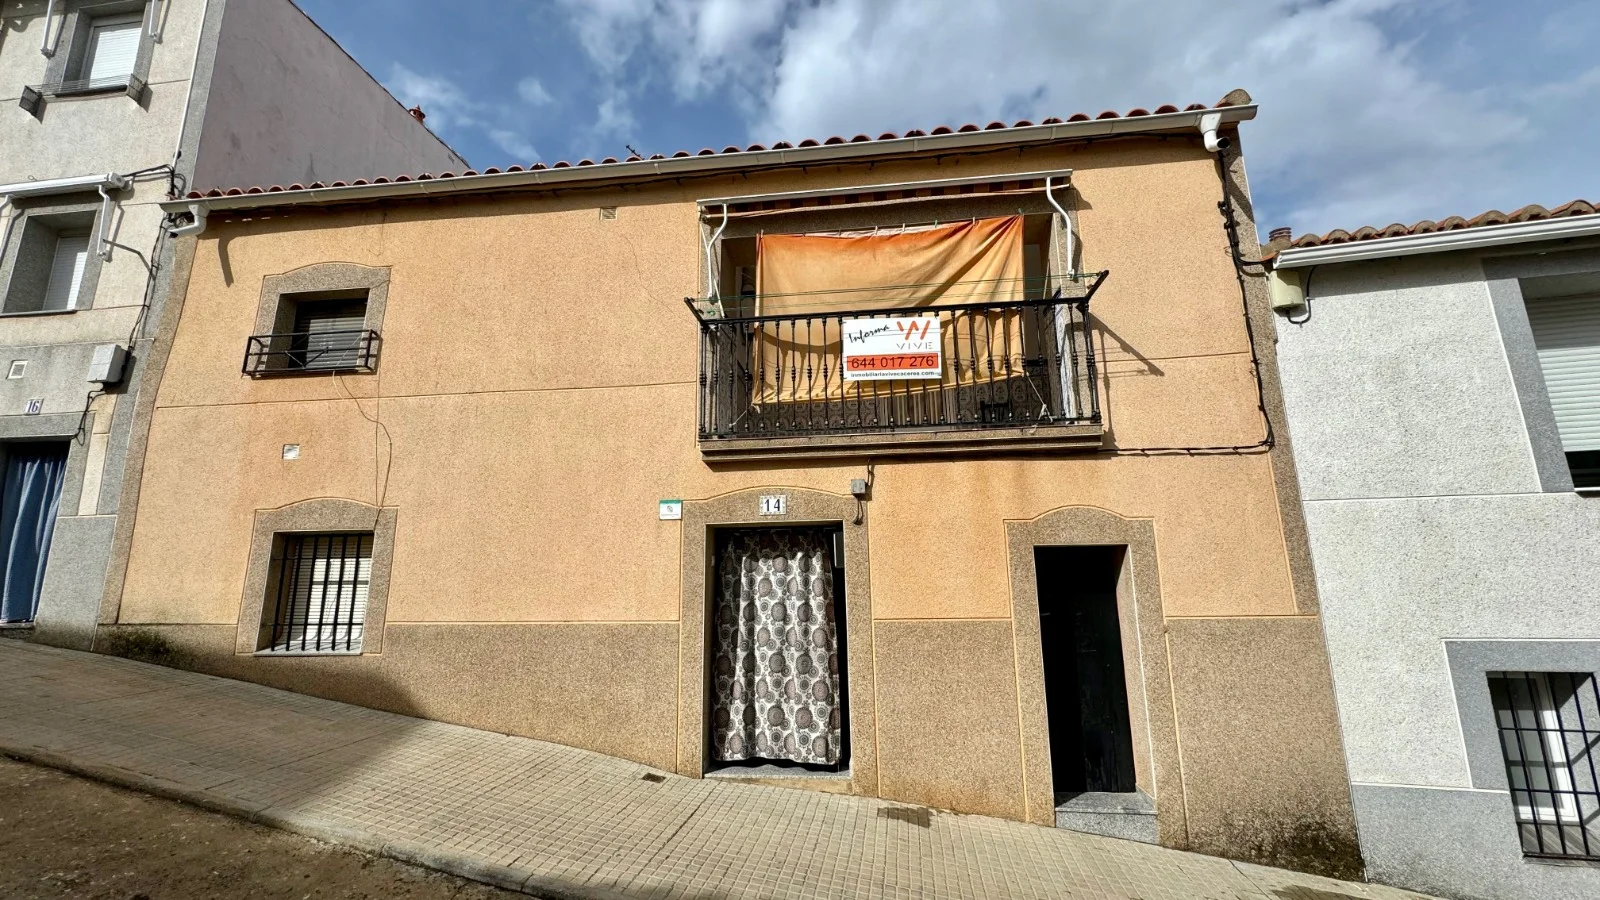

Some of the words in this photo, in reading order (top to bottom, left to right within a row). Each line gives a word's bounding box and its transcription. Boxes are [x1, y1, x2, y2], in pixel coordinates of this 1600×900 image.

[848, 324, 890, 344] Informa
[896, 341, 934, 350] VIVE
[851, 357, 876, 369] 644
[880, 356, 905, 368] 017
[909, 355, 934, 367] 276
[27, 400, 40, 413] 16
[764, 498, 781, 512] 14
